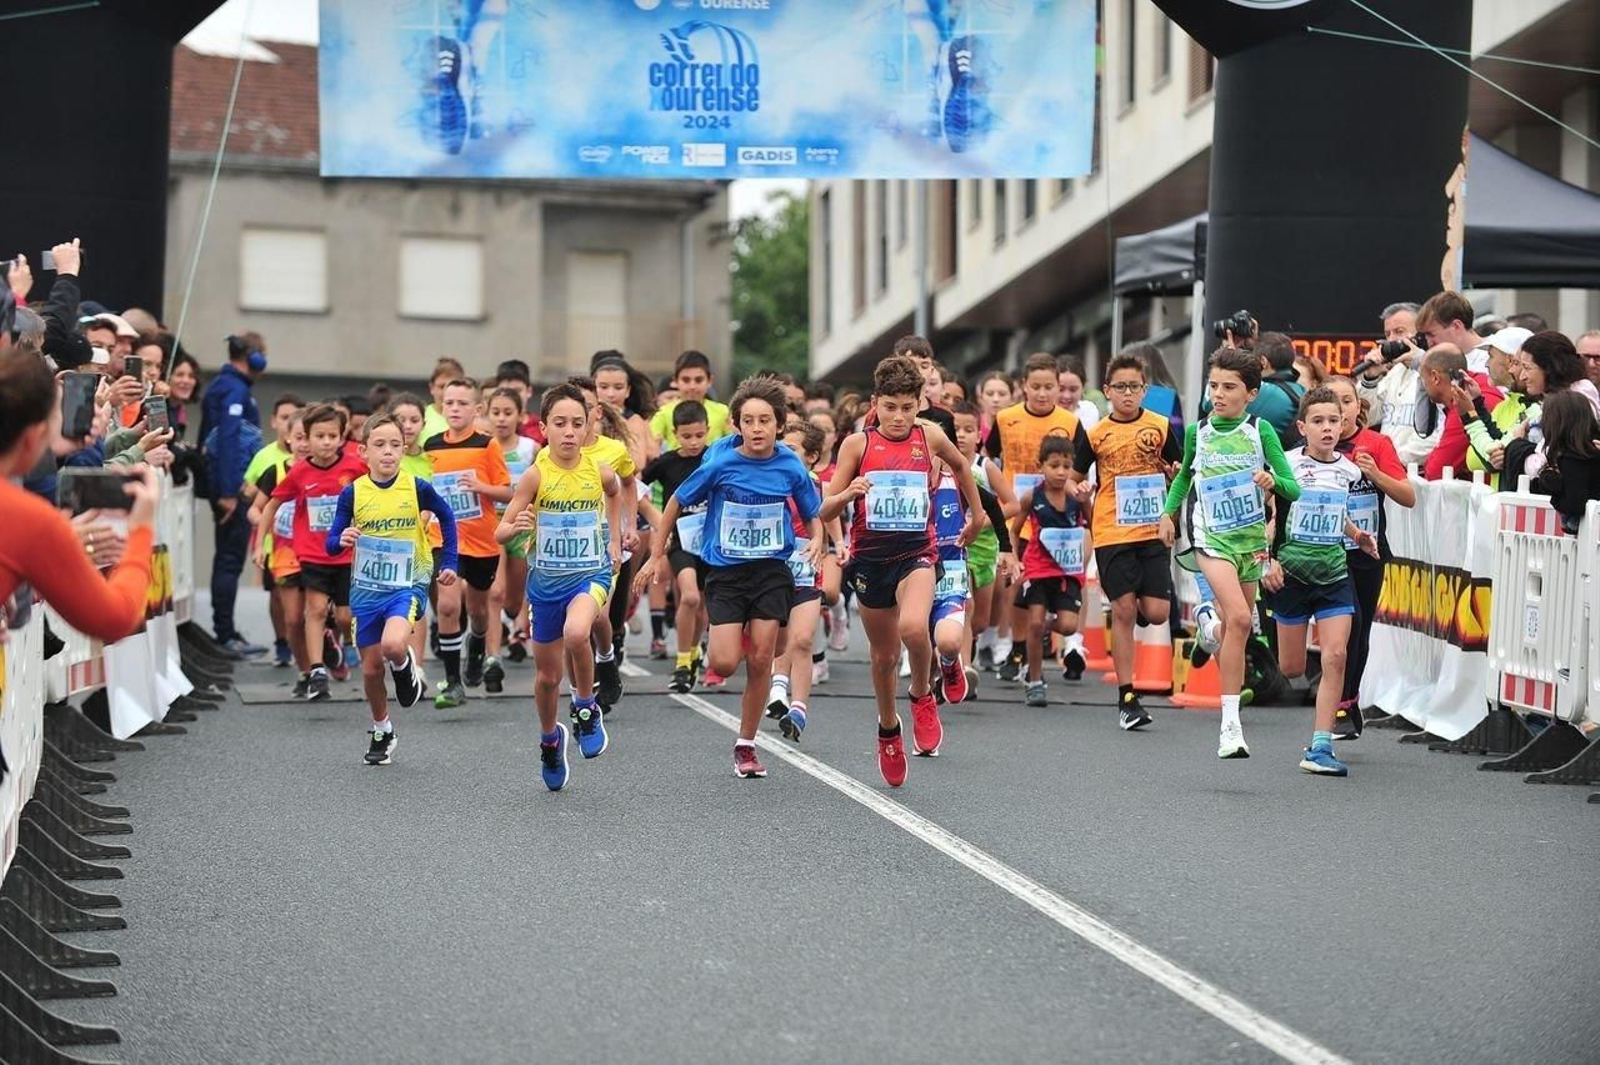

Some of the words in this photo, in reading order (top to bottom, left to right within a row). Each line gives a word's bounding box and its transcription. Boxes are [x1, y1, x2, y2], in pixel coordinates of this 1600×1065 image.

[700, 0, 770, 10] OURENSE
[650, 62, 723, 87] correr
[731, 62, 759, 87] do
[683, 115, 731, 129] 2024
[742, 150, 793, 161] GADIS
[874, 497, 918, 519] 4044
[1123, 497, 1159, 517] 4205
[1213, 494, 1254, 520] 4005
[1300, 513, 1338, 533] 4047
[728, 527, 771, 547] 4308
[543, 538, 589, 558] 4002
[361, 559, 398, 582] 4001
